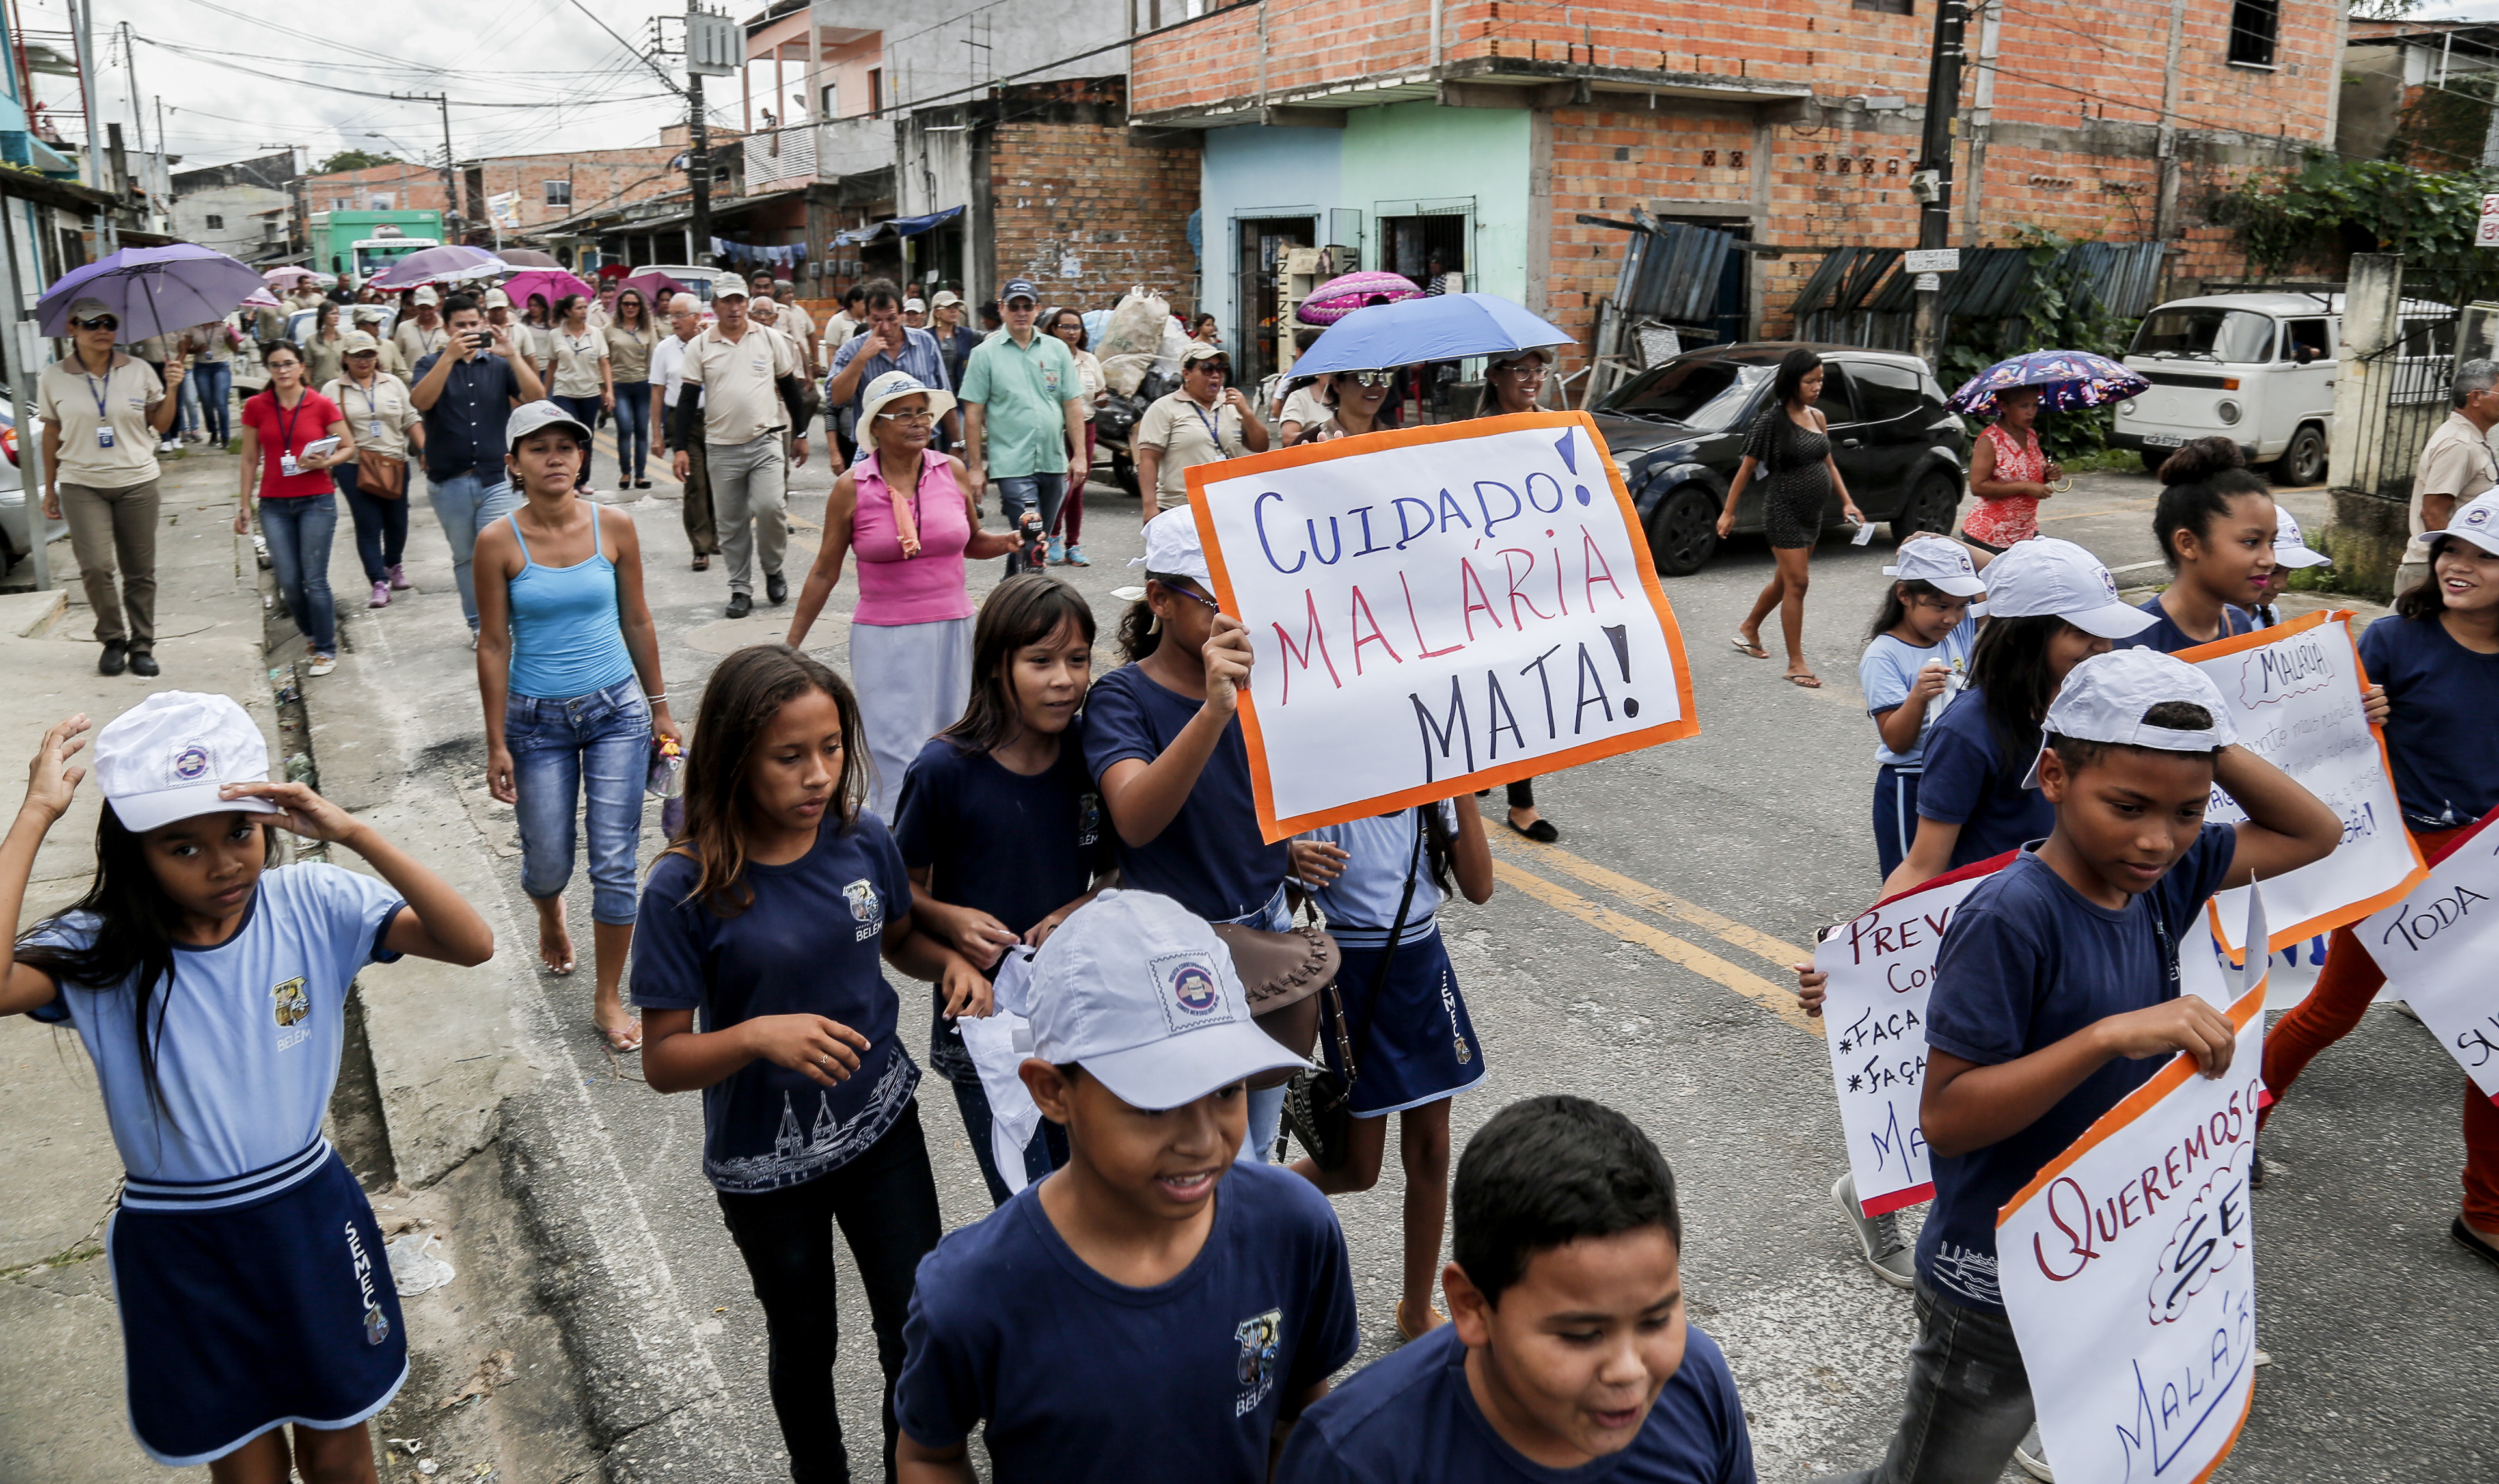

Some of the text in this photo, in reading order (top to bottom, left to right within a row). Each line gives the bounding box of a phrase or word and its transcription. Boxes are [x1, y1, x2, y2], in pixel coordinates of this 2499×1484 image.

[1254, 426, 1591, 574] CUIDADO!
[1408, 624, 1639, 783] MATA!
[856, 920, 882, 942] BELÉM
[1848, 904, 1960, 965] PREV
[2383, 885, 2490, 951] TODA
[277, 1028, 312, 1053] BELÉM
[345, 1220, 376, 1310] SEMEC
